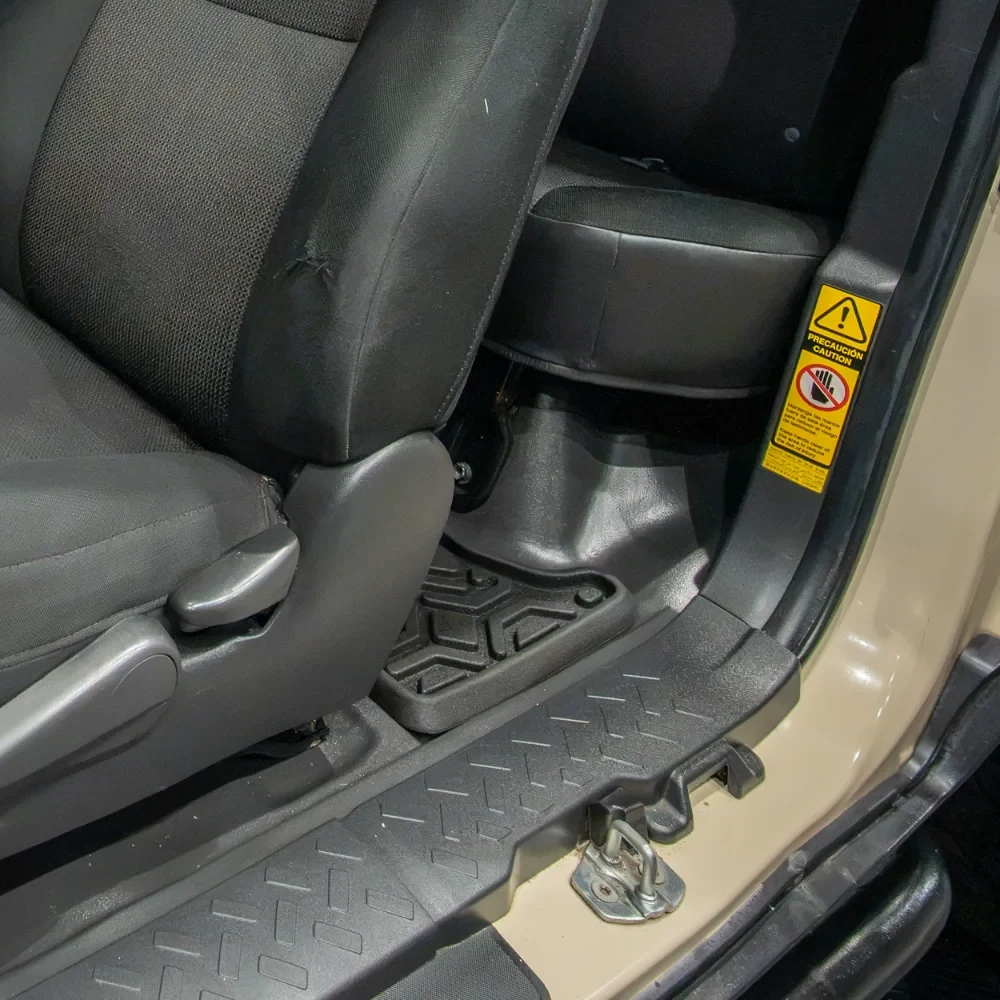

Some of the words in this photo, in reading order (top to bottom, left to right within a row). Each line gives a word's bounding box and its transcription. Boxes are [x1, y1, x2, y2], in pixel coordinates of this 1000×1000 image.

[808, 333, 864, 360] PRECAUCIÓN
[813, 345, 852, 366] CAUTION
[788, 403, 812, 416] Mantenga
[780, 428, 792, 437] Keep
[794, 433, 809, 443] hands
